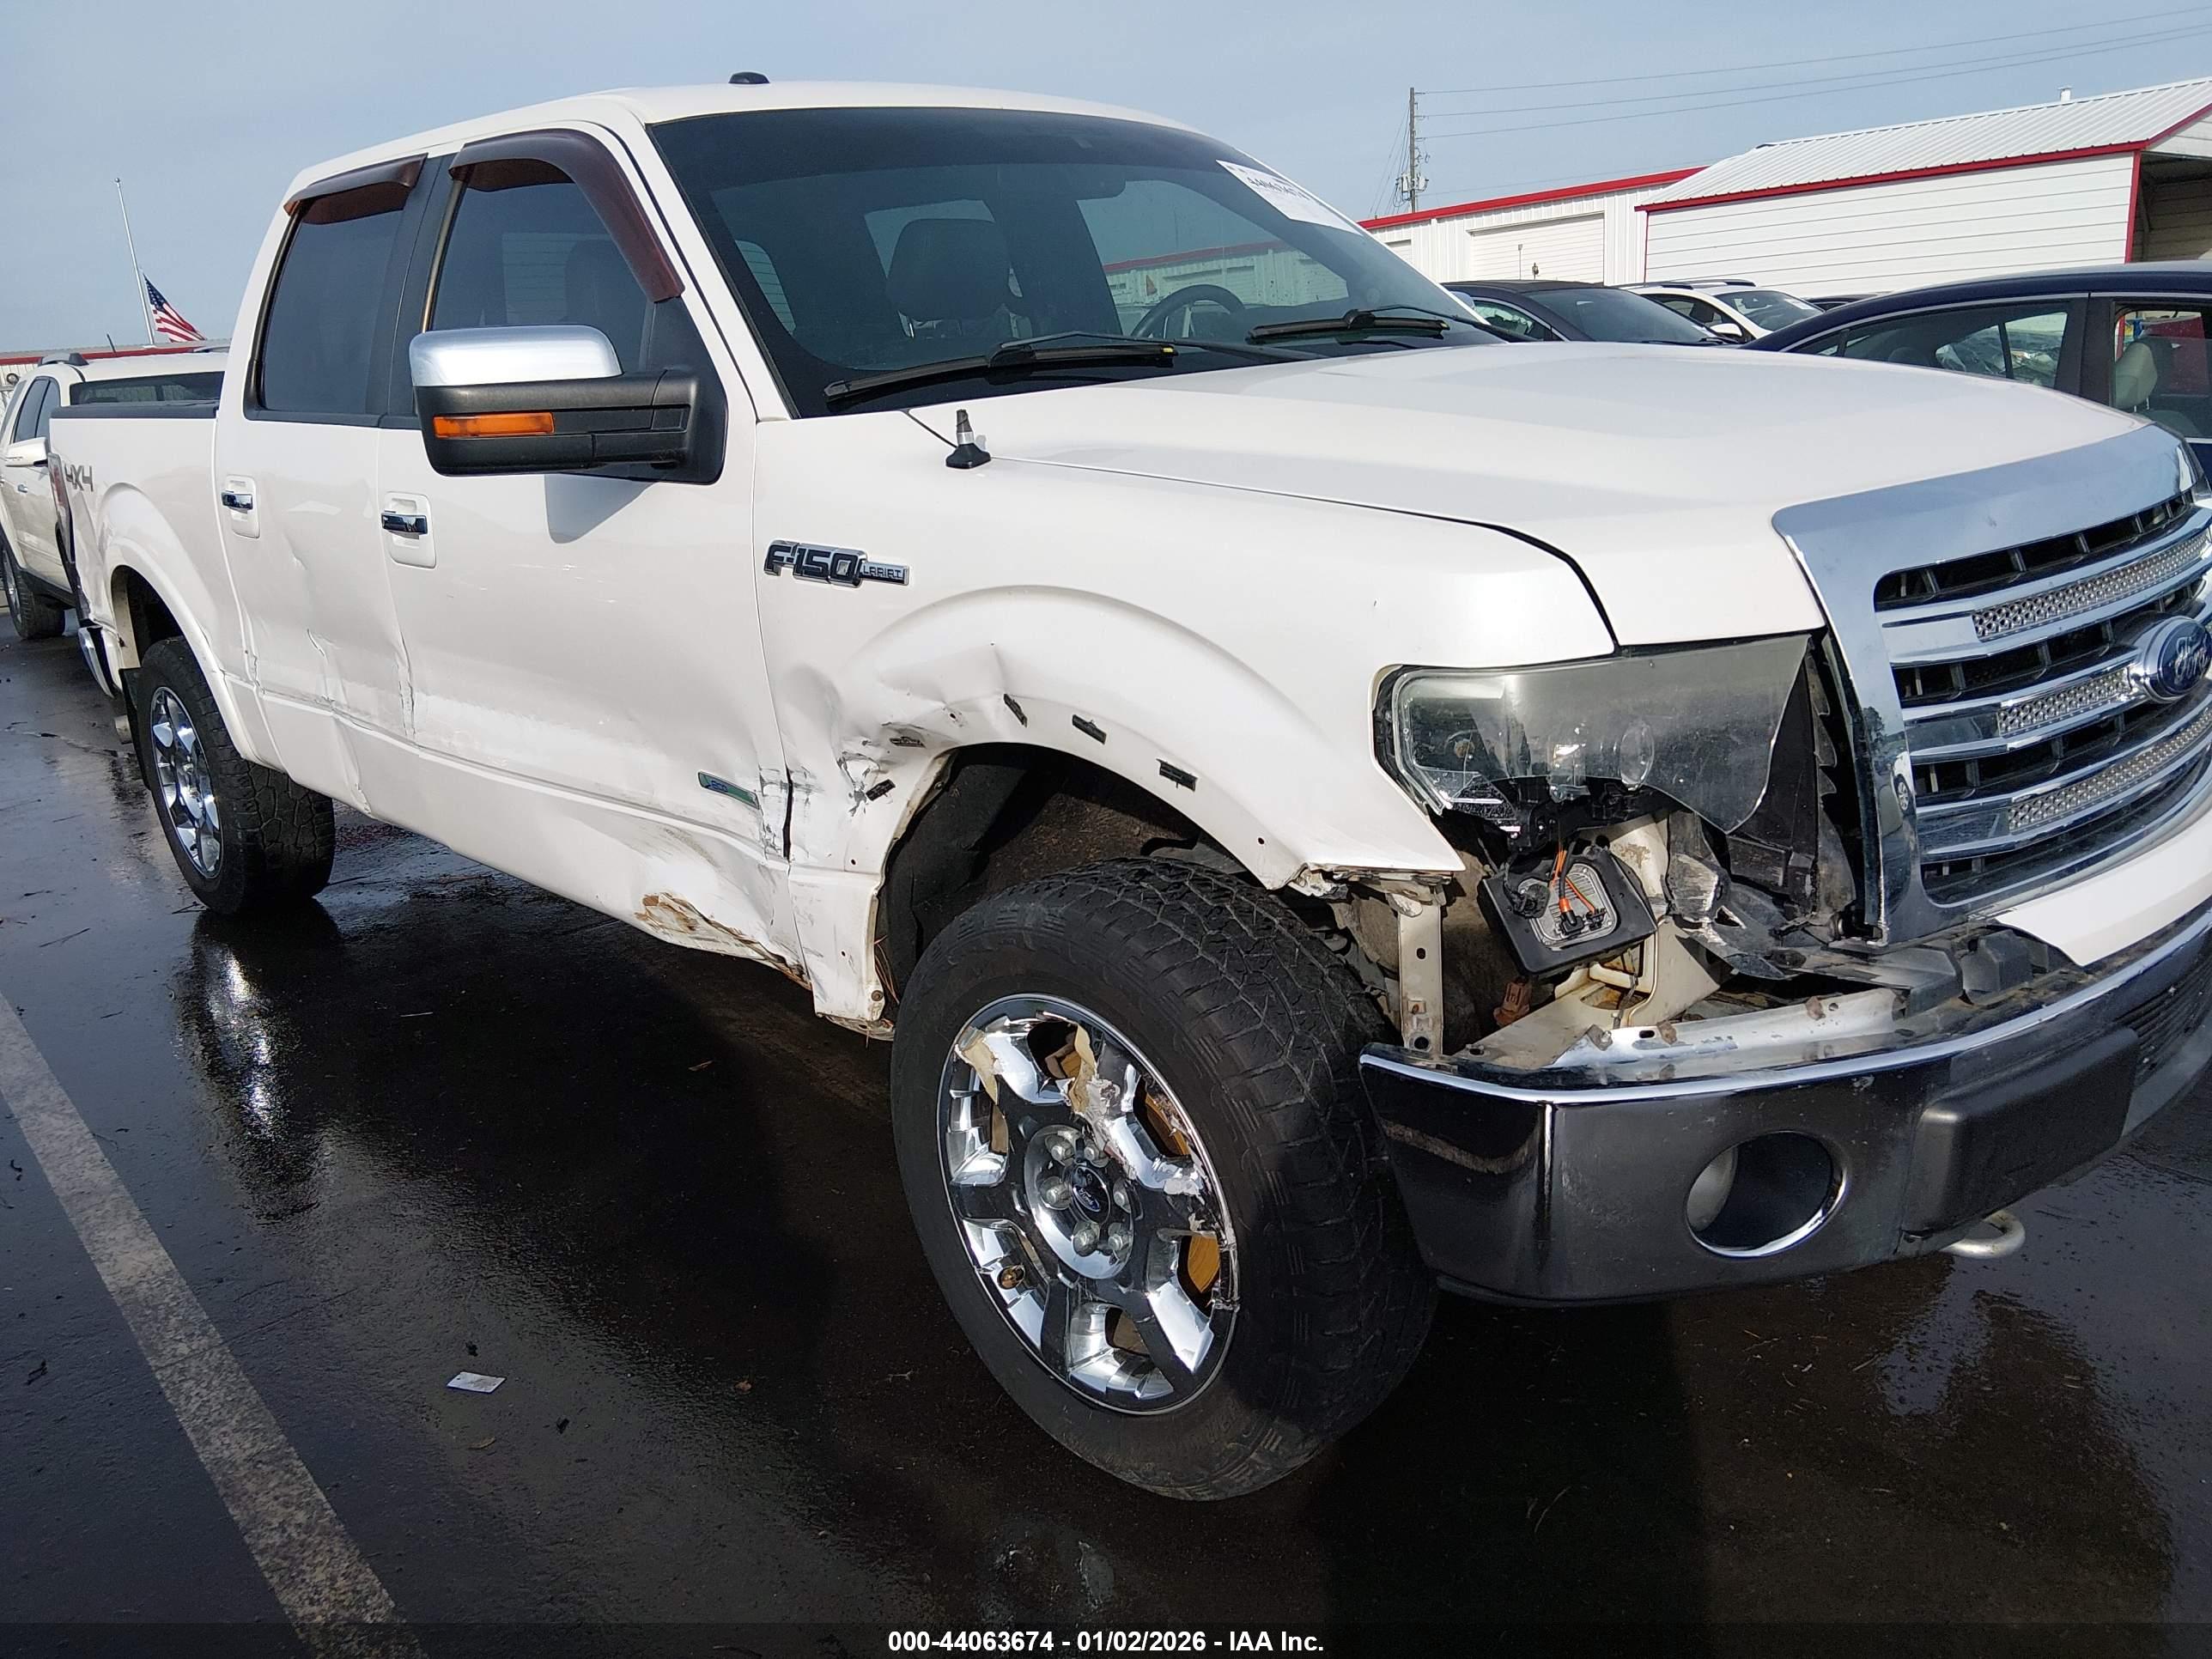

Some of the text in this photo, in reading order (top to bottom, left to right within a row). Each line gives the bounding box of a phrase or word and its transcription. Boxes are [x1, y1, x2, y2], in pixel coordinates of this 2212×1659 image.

[763, 540, 902, 587] F-150 LARIAT
[2170, 633, 2211, 684] Ford
